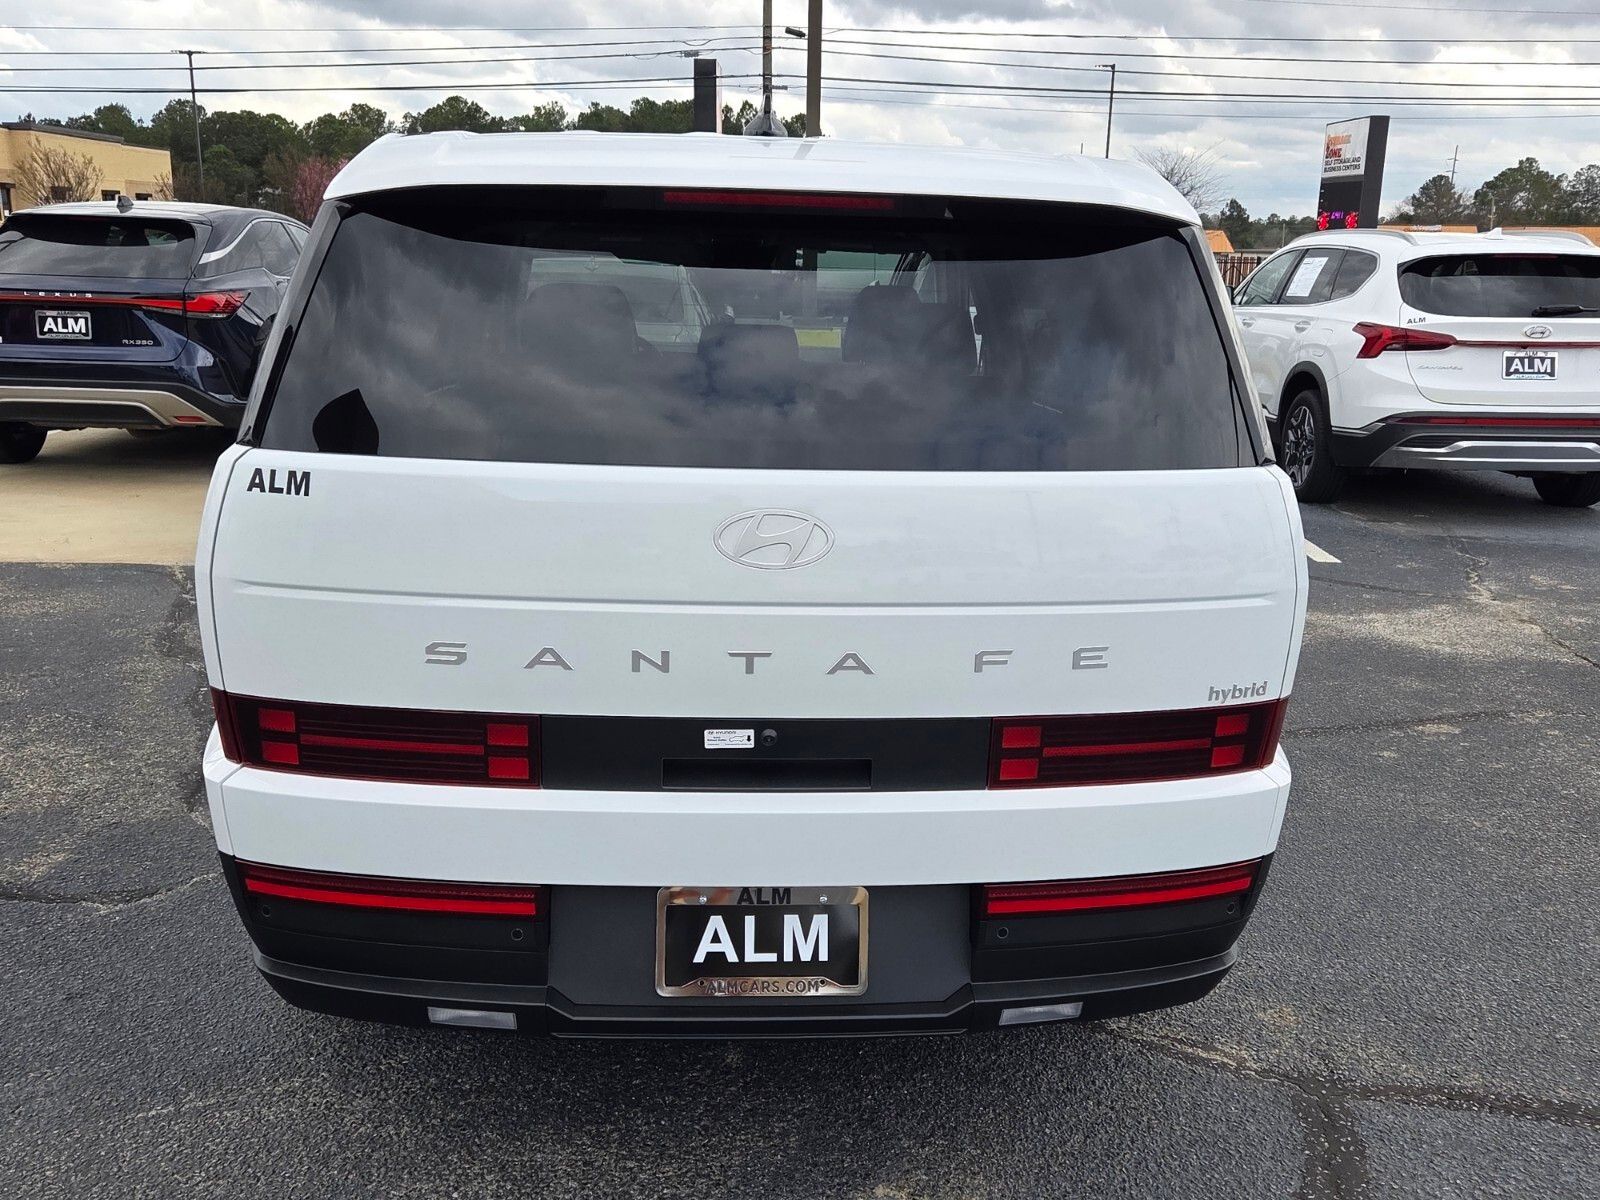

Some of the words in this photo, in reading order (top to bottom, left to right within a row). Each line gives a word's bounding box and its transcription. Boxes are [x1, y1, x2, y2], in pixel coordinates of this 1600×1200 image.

[1324, 165, 1341, 173] BUSINESS
[1333, 157, 1352, 165] STORAGE
[43, 317, 86, 333] ALM
[1509, 358, 1551, 373] ALM
[247, 468, 311, 497] ALM
[424, 641, 876, 675] SANTA
[973, 645, 1110, 674] FE
[1208, 681, 1268, 704] hybrid
[737, 887, 791, 905] ALM
[693, 914, 829, 963] ALM
[705, 979, 820, 995] ALMCARS.COM
